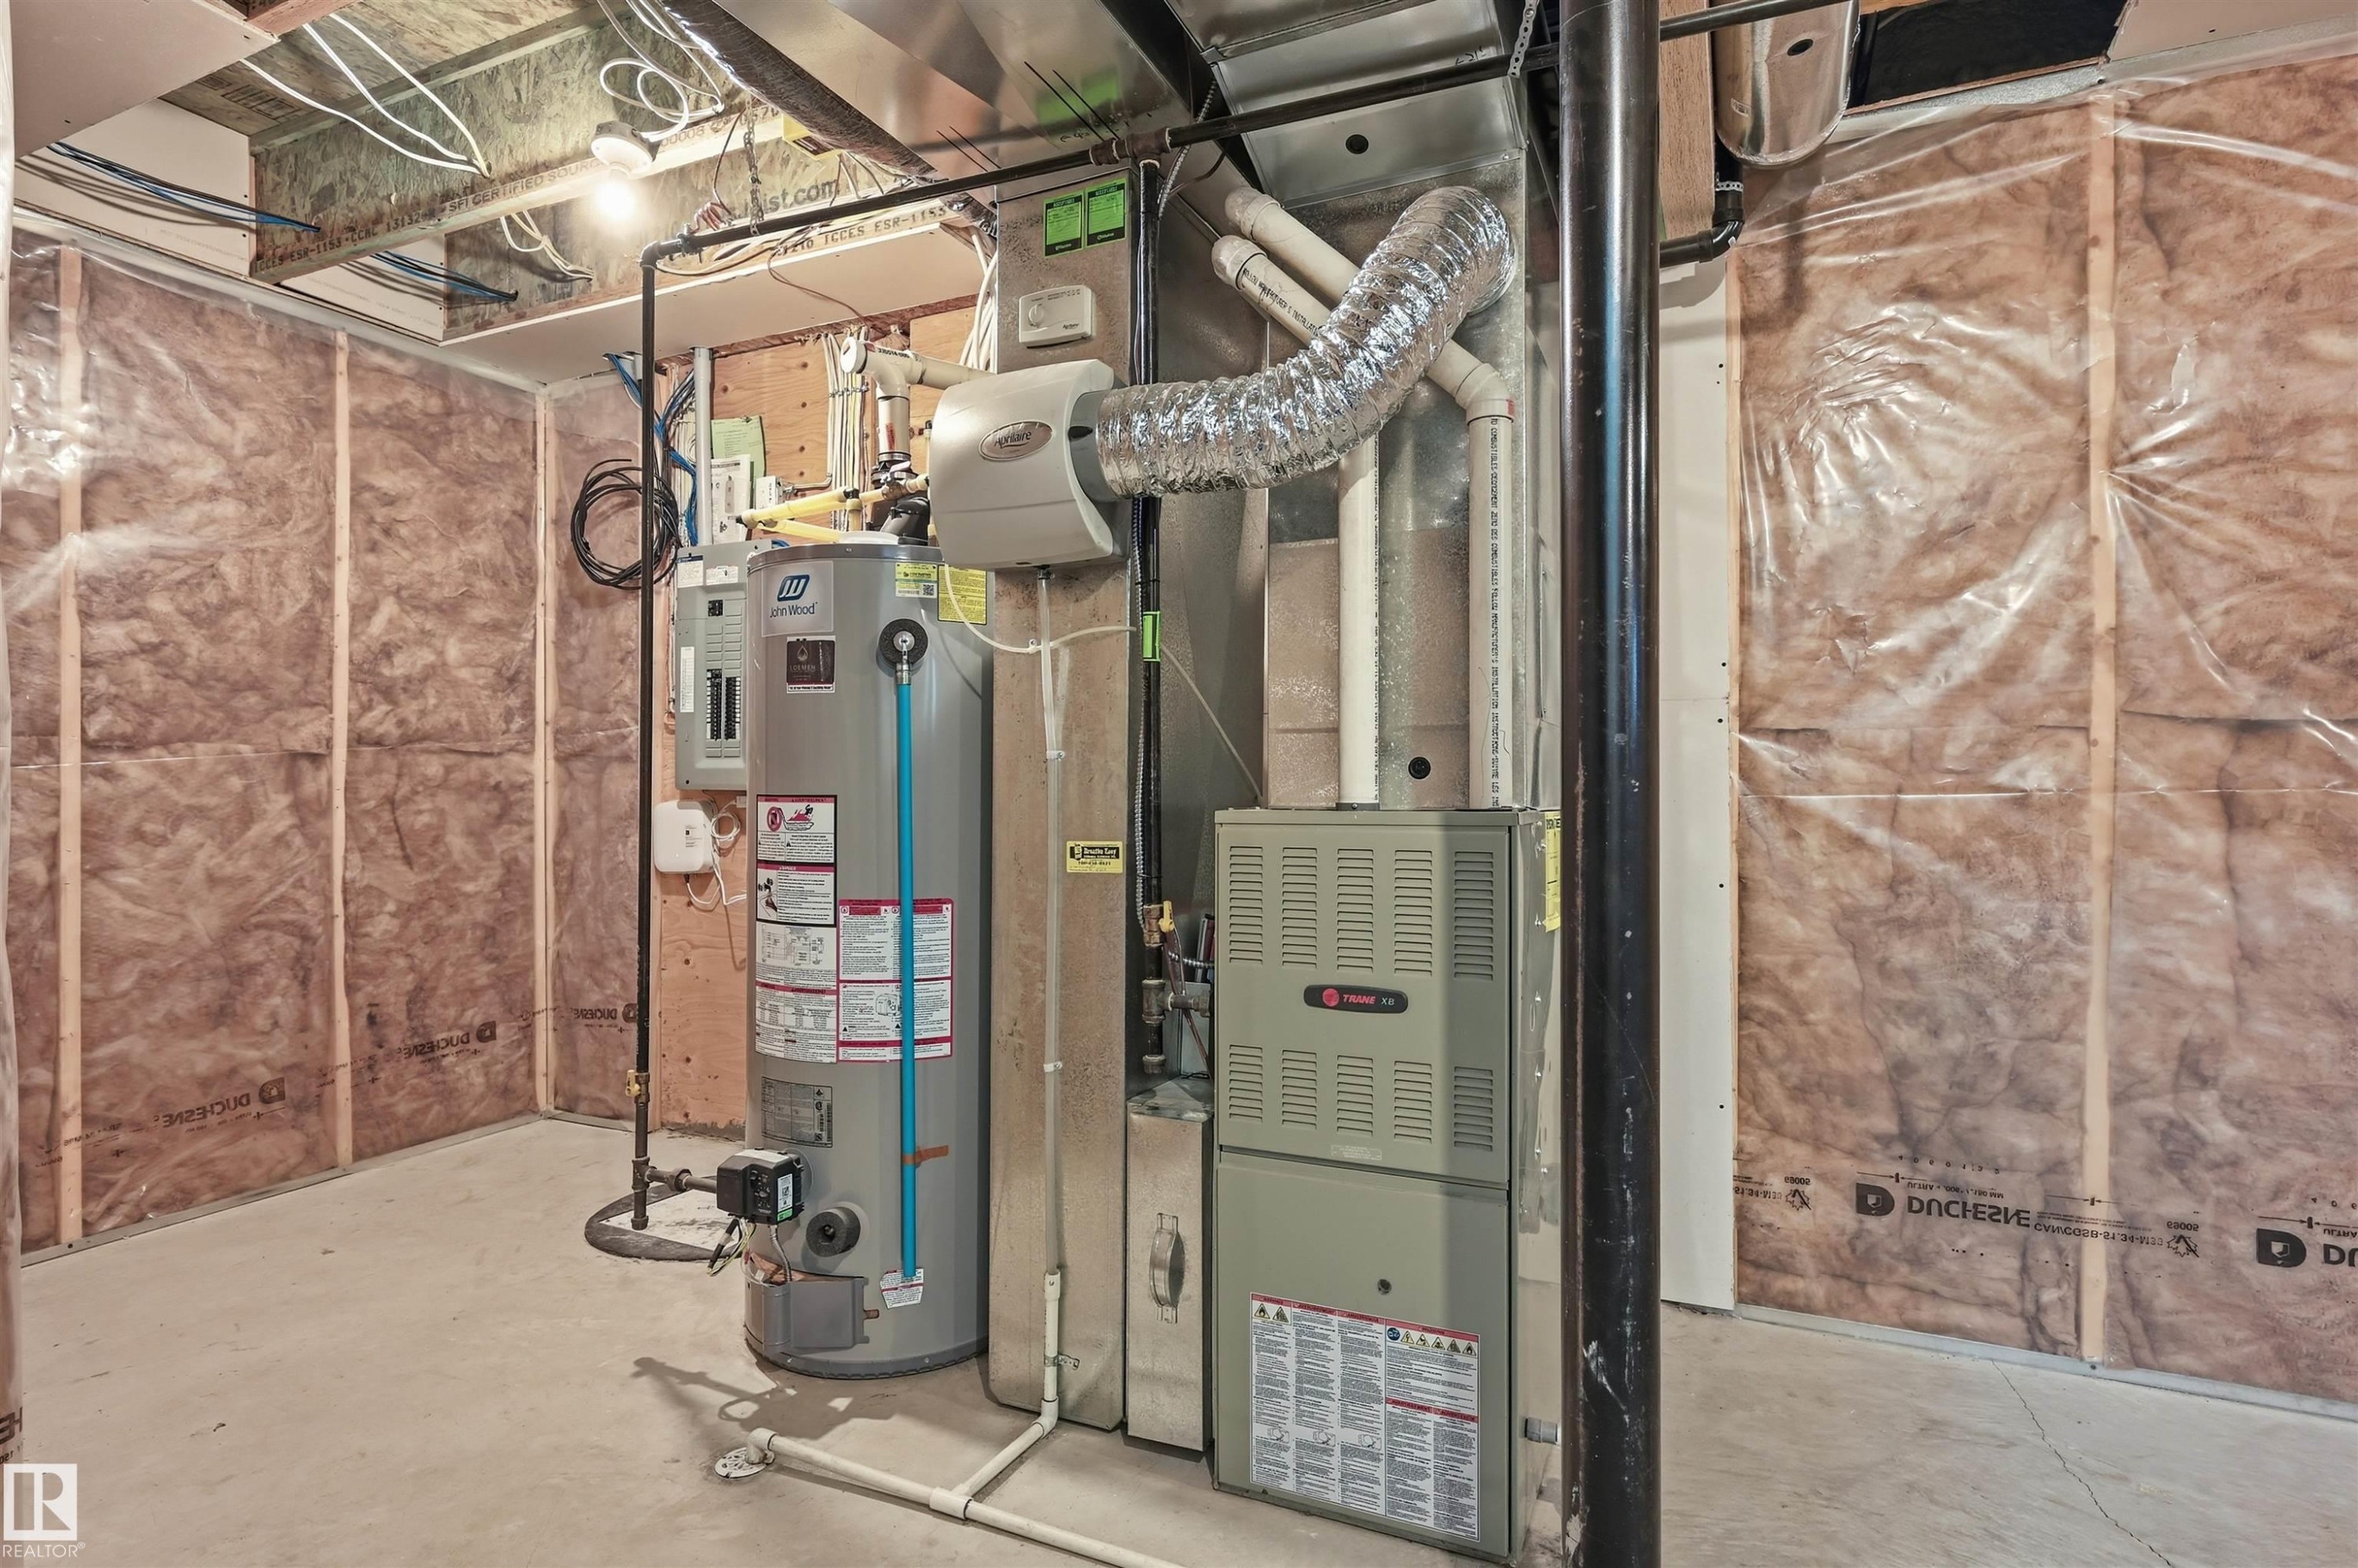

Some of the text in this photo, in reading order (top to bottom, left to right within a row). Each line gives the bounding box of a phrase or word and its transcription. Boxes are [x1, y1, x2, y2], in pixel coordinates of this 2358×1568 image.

[449, 199, 469, 213] SFI
[473, 177, 544, 204] CERTIFIED
[825, 225, 865, 246] ICCES
[874, 207, 946, 232] ESR-1153
[289, 237, 342, 261] ESR-1153
[351, 226, 378, 244] CCMC
[994, 431, 1032, 449] Aprilaire
[769, 602, 815, 619] John Wood
[1342, 993, 1395, 1006] TRANE XB
